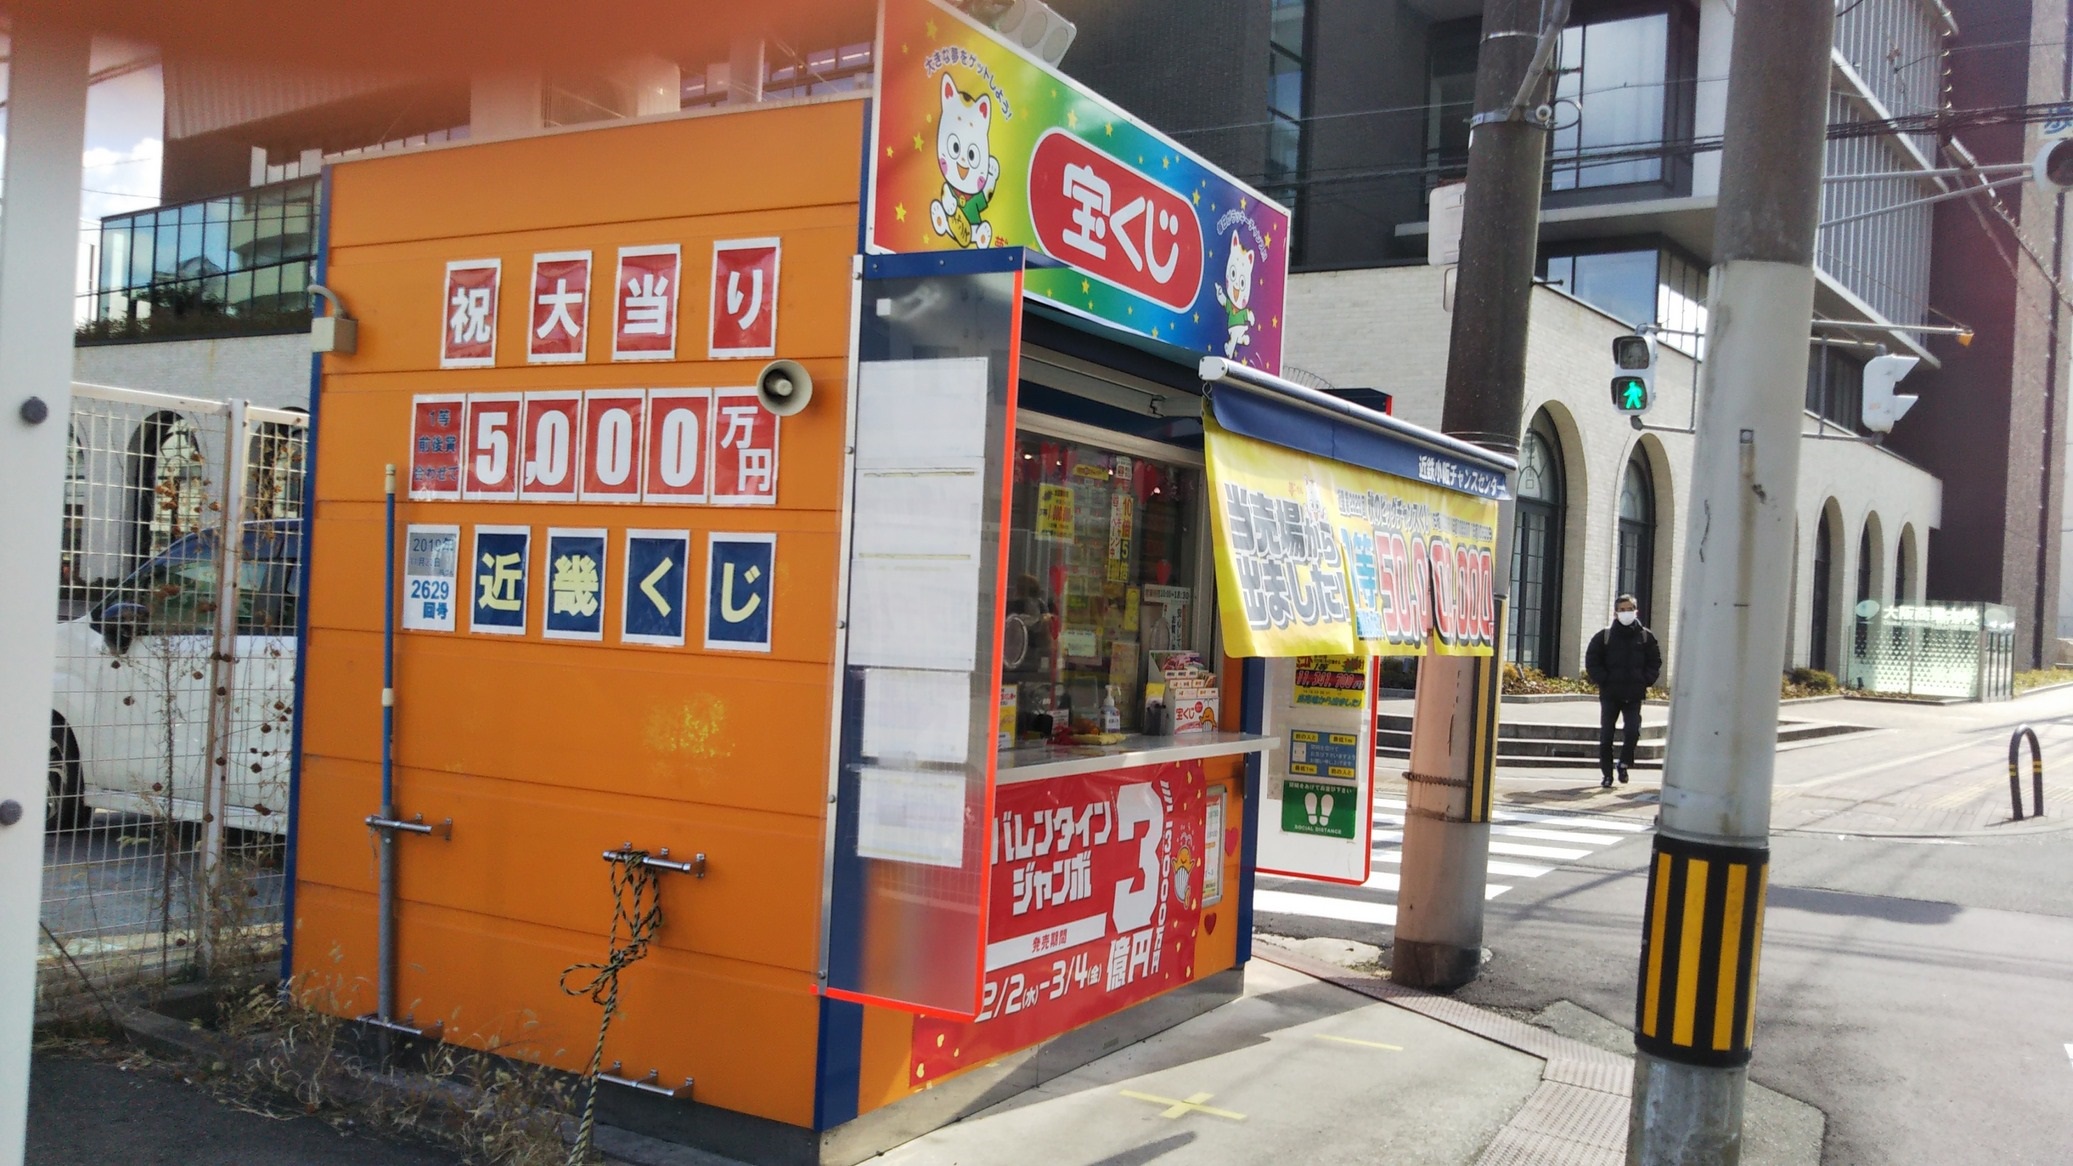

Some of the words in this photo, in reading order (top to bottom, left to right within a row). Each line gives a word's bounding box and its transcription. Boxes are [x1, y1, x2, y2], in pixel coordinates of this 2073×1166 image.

[1061, 164, 1180, 285] 宝くじ
[418, 435, 457, 453] 前後賞
[474, 404, 773, 493] 5,000万円
[414, 465, 459, 481] 合わせて
[1418, 455, 1506, 497] 近鉄小阪チャンスセンター
[1224, 482, 1342, 568] 当売場から
[410, 579, 450, 600] 2629
[477, 552, 762, 624] 近畿くじ
[1175, 707, 1195, 721] 宝くじ
[991, 800, 1112, 866] バレンタイン
[1294, 824, 1314, 832] SOCIAL
[1314, 827, 1342, 835] DISTANCE
[1012, 849, 1092, 916] ジャンボ
[1032, 928, 1068, 953] 発売期間
